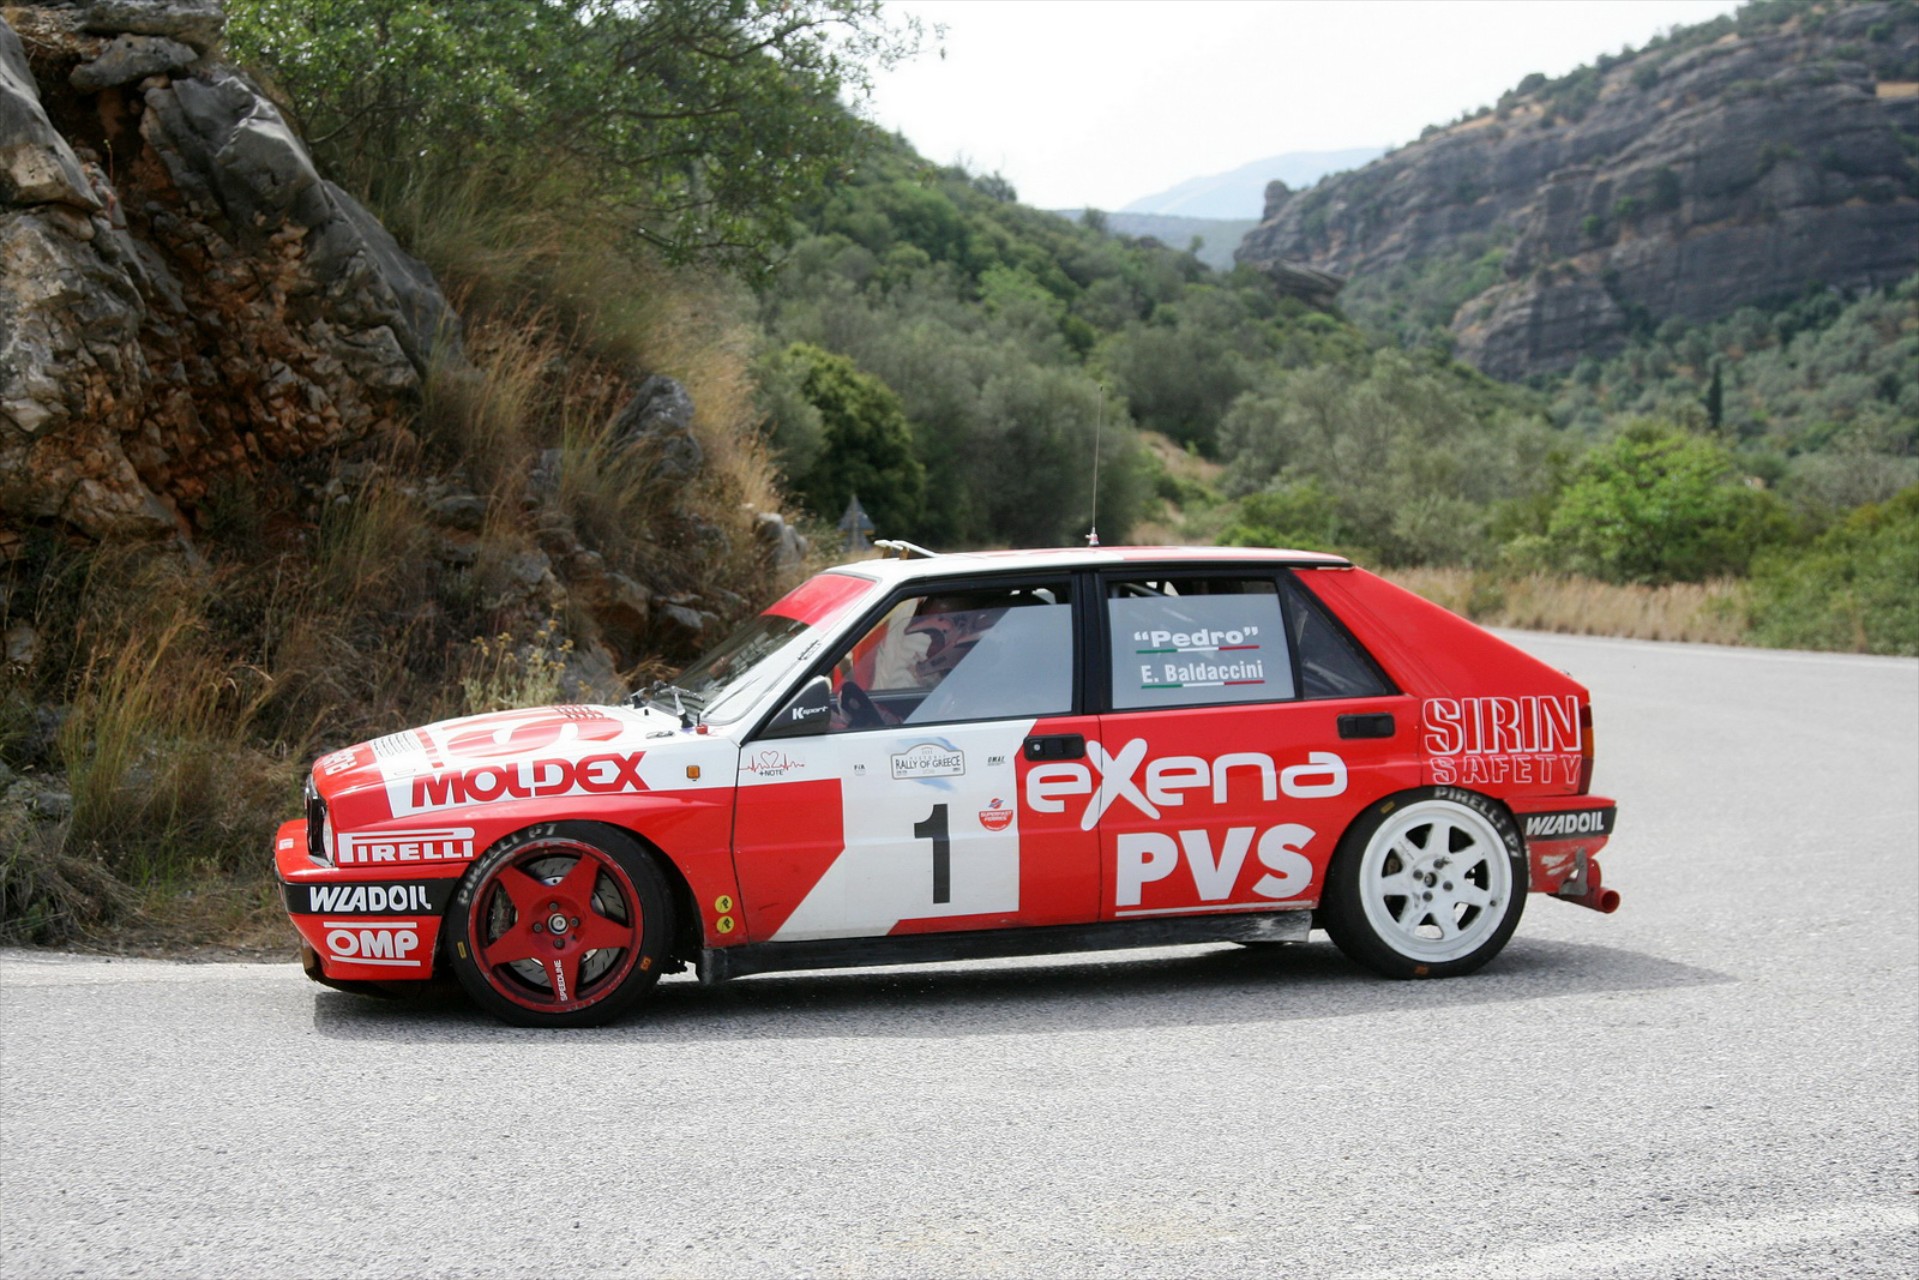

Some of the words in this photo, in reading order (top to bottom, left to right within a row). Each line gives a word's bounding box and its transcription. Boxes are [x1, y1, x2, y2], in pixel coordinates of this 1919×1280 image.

[1141, 665, 1159, 683] E.
[1165, 660, 1264, 682] Baldaccini
[1422, 695, 1582, 755] SIRIN
[896, 759, 918, 769] RALLY
[920, 760, 930, 768] OF
[932, 756, 961, 768] GREECE
[1429, 754, 1582, 785] SAFETY
[412, 751, 651, 808] MOLDEX
[1526, 812, 1604, 836] WLADOIL
[338, 827, 475, 863] PIRELLI
[914, 803, 950, 905] 1
[1115, 823, 1317, 906] PVS
[310, 885, 432, 912] WLADOIL
[327, 929, 419, 959] OMP
[553, 960, 568, 1002] SPEEDLINE
